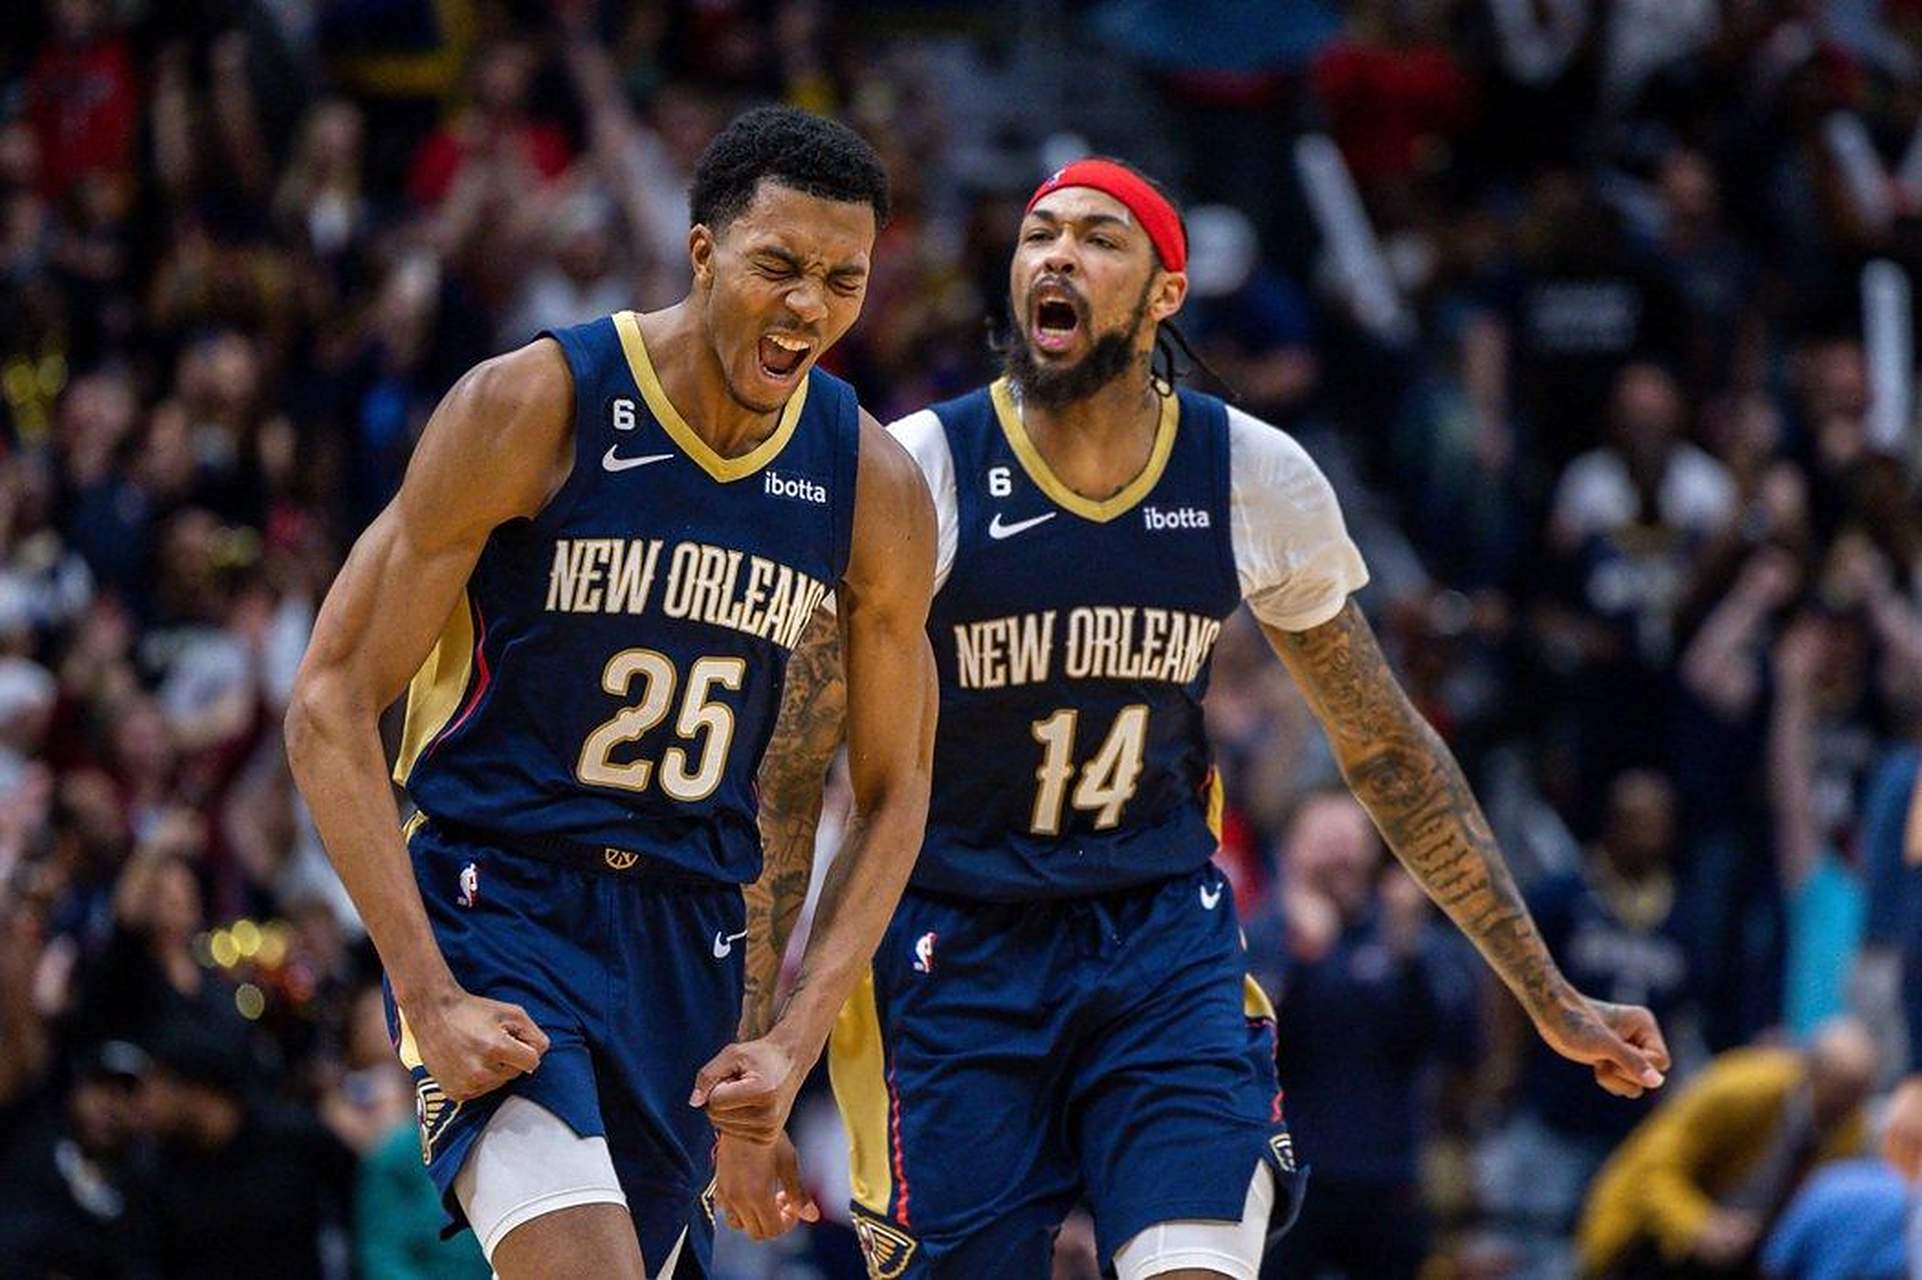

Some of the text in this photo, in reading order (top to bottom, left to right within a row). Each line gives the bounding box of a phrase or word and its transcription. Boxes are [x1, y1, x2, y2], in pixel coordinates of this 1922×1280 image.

[612, 399, 636, 430] 6
[764, 471, 827, 503] ibotta
[988, 467, 1012, 497] 6
[1144, 507, 1210, 530] ibotta
[545, 539, 664, 615] NEW
[954, 610, 1056, 689] NEW
[576, 648, 746, 802] 25
[1030, 703, 1150, 836] 14
